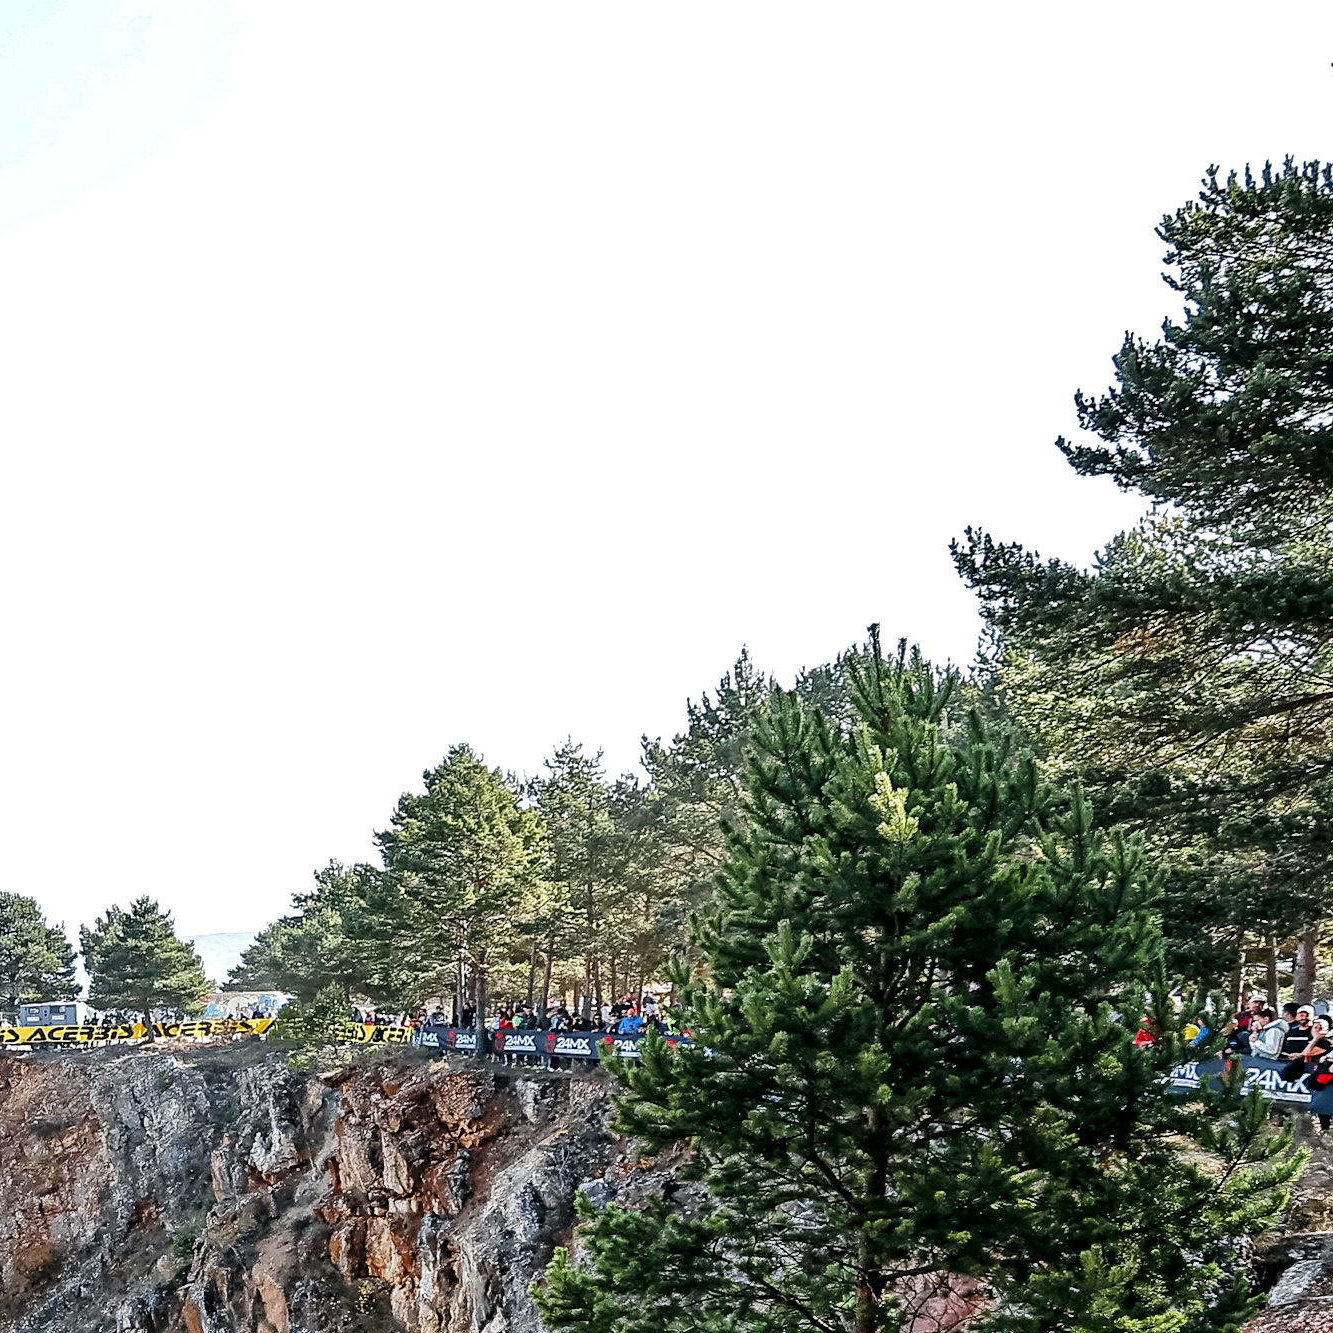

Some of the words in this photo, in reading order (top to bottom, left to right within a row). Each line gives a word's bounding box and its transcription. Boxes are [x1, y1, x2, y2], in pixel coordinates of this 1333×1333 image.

[26, 1026, 133, 1042] ACERBIS
[455, 1033, 476, 1045] 24M
[504, 1034, 535, 1046] 24MX
[556, 1036, 590, 1051] 24MX
[613, 1039, 637, 1051] 24M
